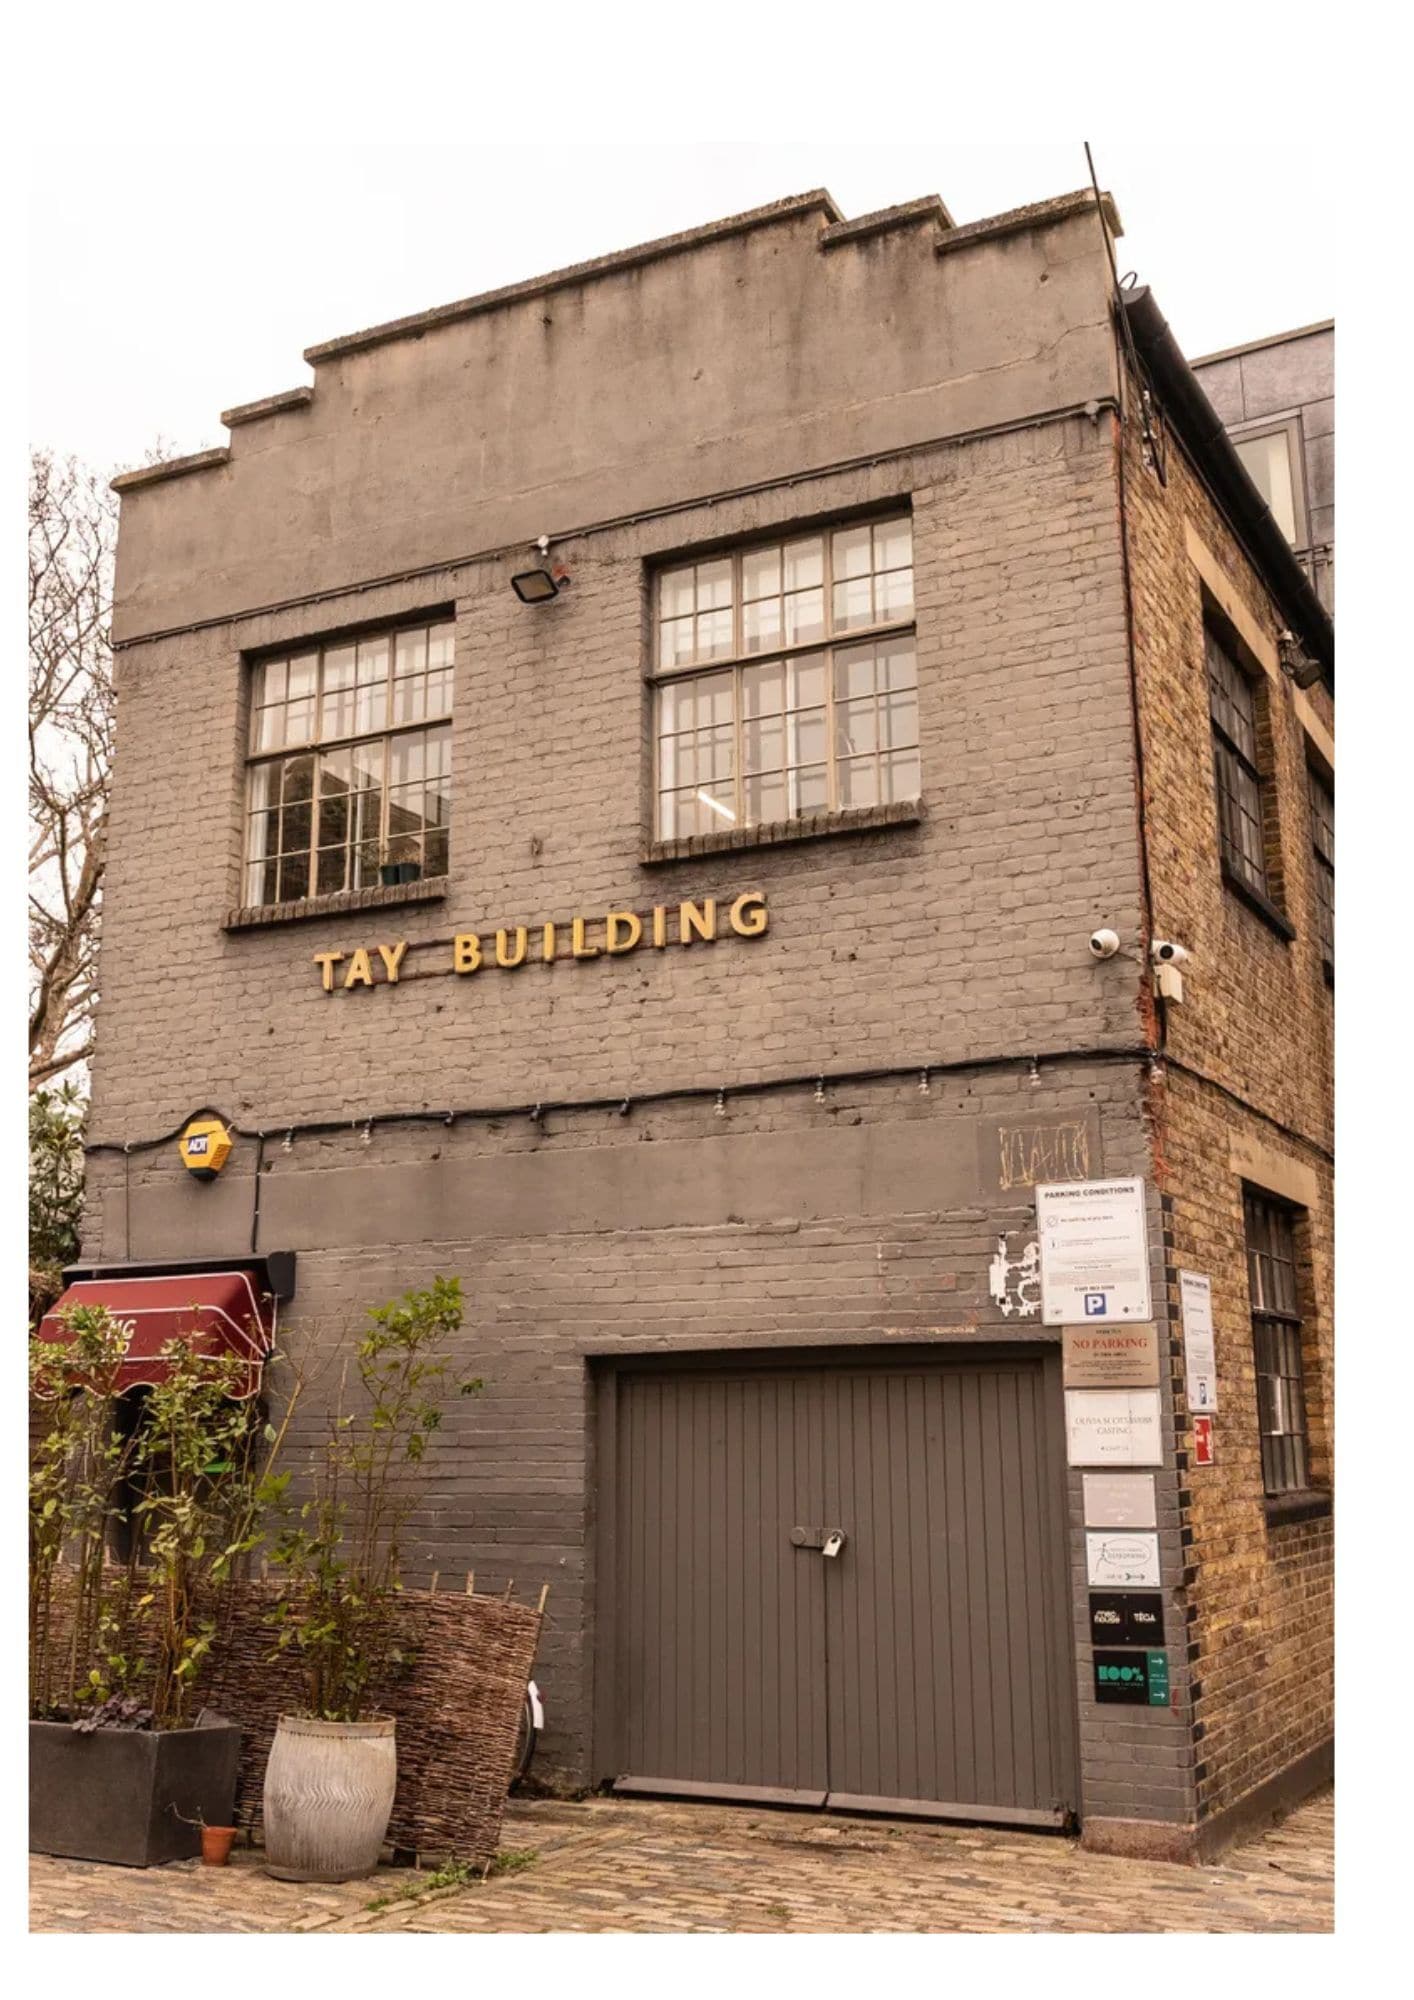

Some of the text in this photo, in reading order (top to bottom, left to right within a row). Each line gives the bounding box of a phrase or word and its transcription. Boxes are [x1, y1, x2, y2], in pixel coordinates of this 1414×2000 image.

[313, 892, 769, 991] TAY BUILDING
[188, 1136, 208, 1153] ADT
[1044, 1186, 1135, 1199] PARKING CONDITIONS
[1072, 1337, 1148, 1350] NO PARKING
[1097, 1427, 1132, 1435] CASTING
